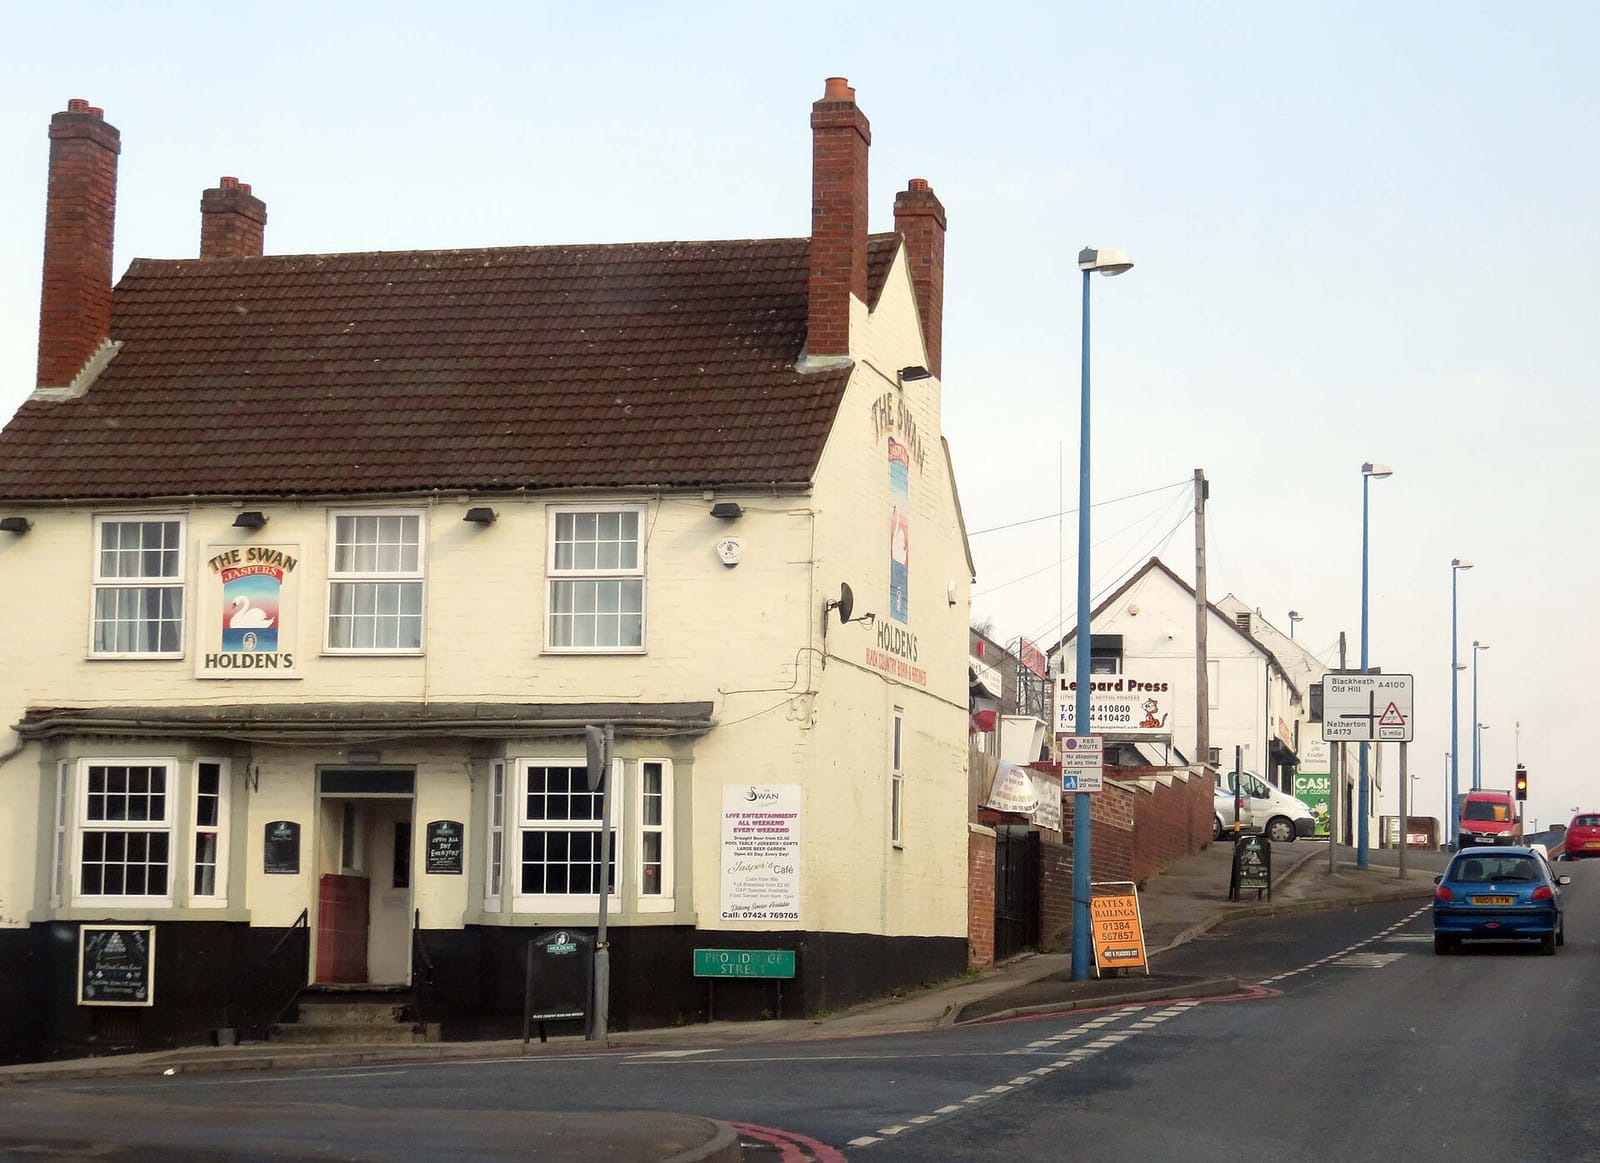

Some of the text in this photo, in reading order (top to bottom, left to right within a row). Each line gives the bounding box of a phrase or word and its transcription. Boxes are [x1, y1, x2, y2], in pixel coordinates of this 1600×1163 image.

[871, 392, 925, 476] THE SWAN
[208, 547, 298, 573] THE SWAN
[224, 566, 278, 582] JASPERS
[205, 653, 293, 669] HOLDEN'S
[1060, 678, 1168, 695] Lepard Press
[1097, 704, 1131, 712] 410800
[1097, 714, 1131, 722] 410420
[773, 865, 794, 875] Café
[1094, 899, 1133, 909] GATES &
[1095, 909, 1135, 918] RAILINGS
[1103, 922, 1130, 931] 01384
[1102, 932, 1133, 940] 567857
